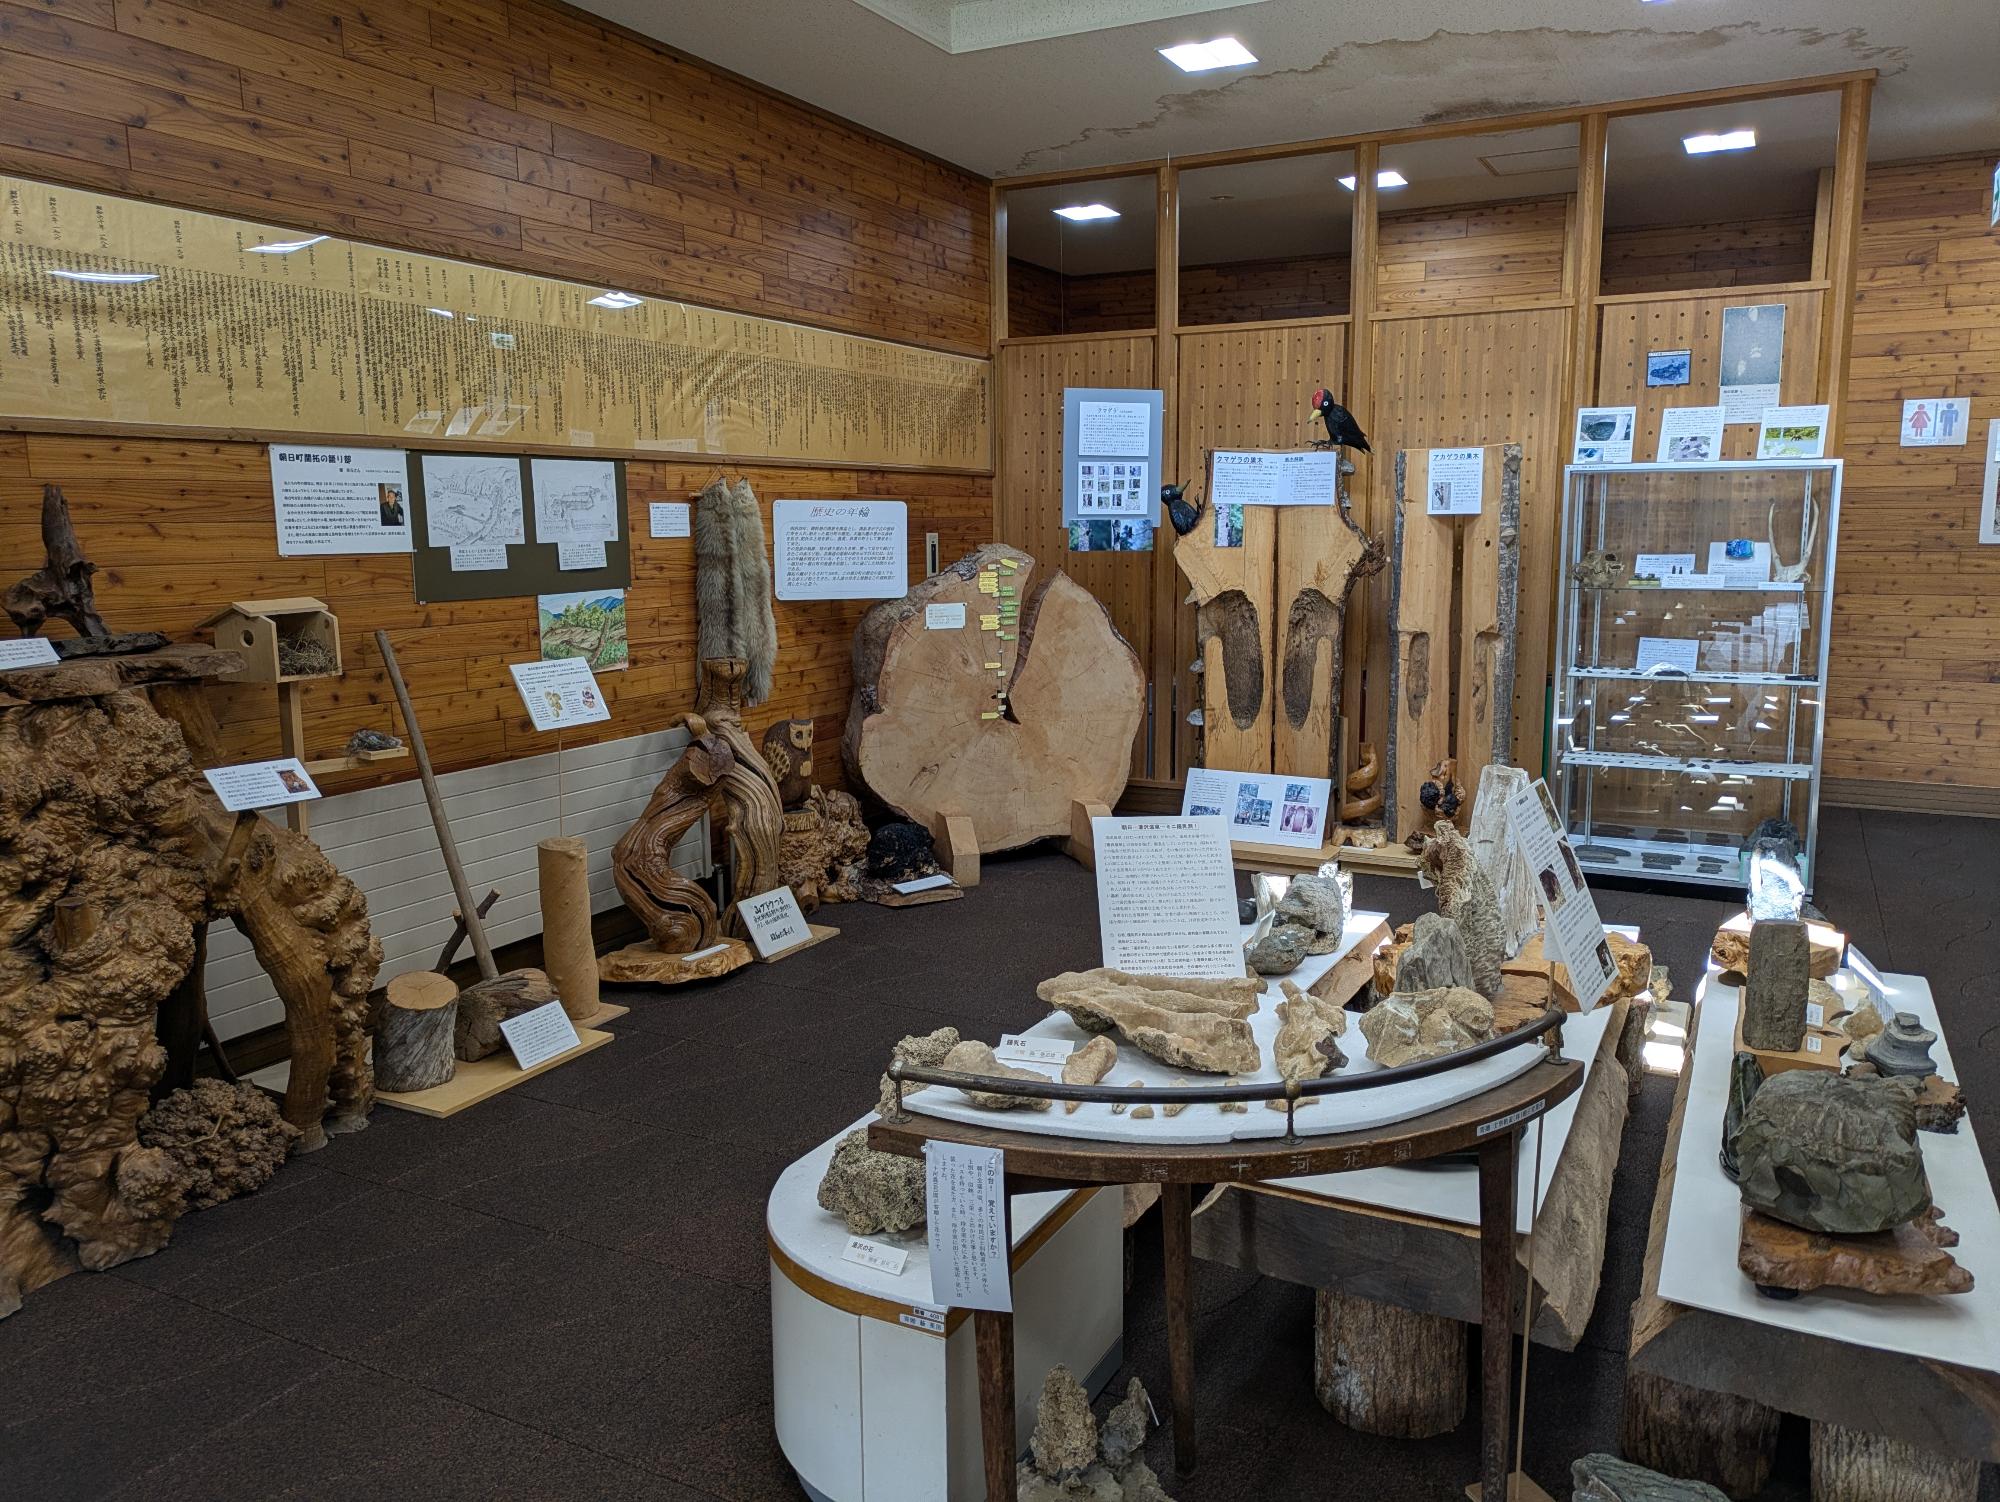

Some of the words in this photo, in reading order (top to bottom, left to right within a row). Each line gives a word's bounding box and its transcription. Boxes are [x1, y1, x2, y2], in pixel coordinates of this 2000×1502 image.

[278, 453, 352, 464] 朝日町開拓の語り部
[810, 506, 870, 518] 歴史の年輪
[851, 1241, 875, 1253] 湯沢の石
